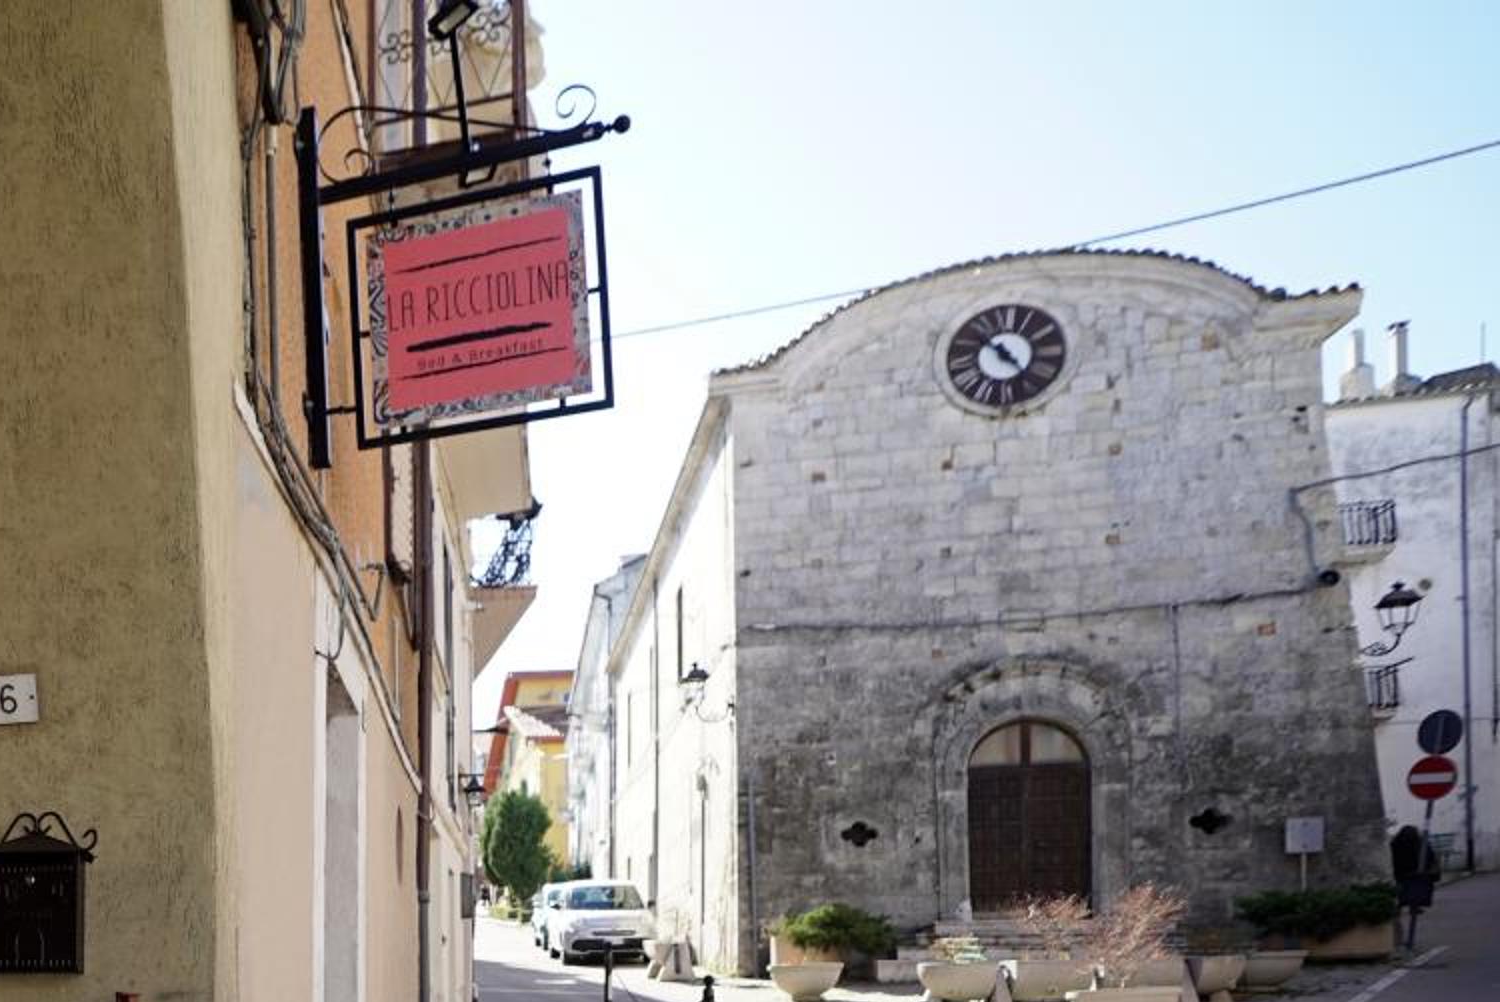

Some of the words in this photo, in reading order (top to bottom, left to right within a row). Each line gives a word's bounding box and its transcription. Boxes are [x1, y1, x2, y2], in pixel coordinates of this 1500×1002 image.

[387, 291, 415, 332] LA
[426, 260, 570, 324] RICCIOLINA
[0, 683, 17, 714] 6
